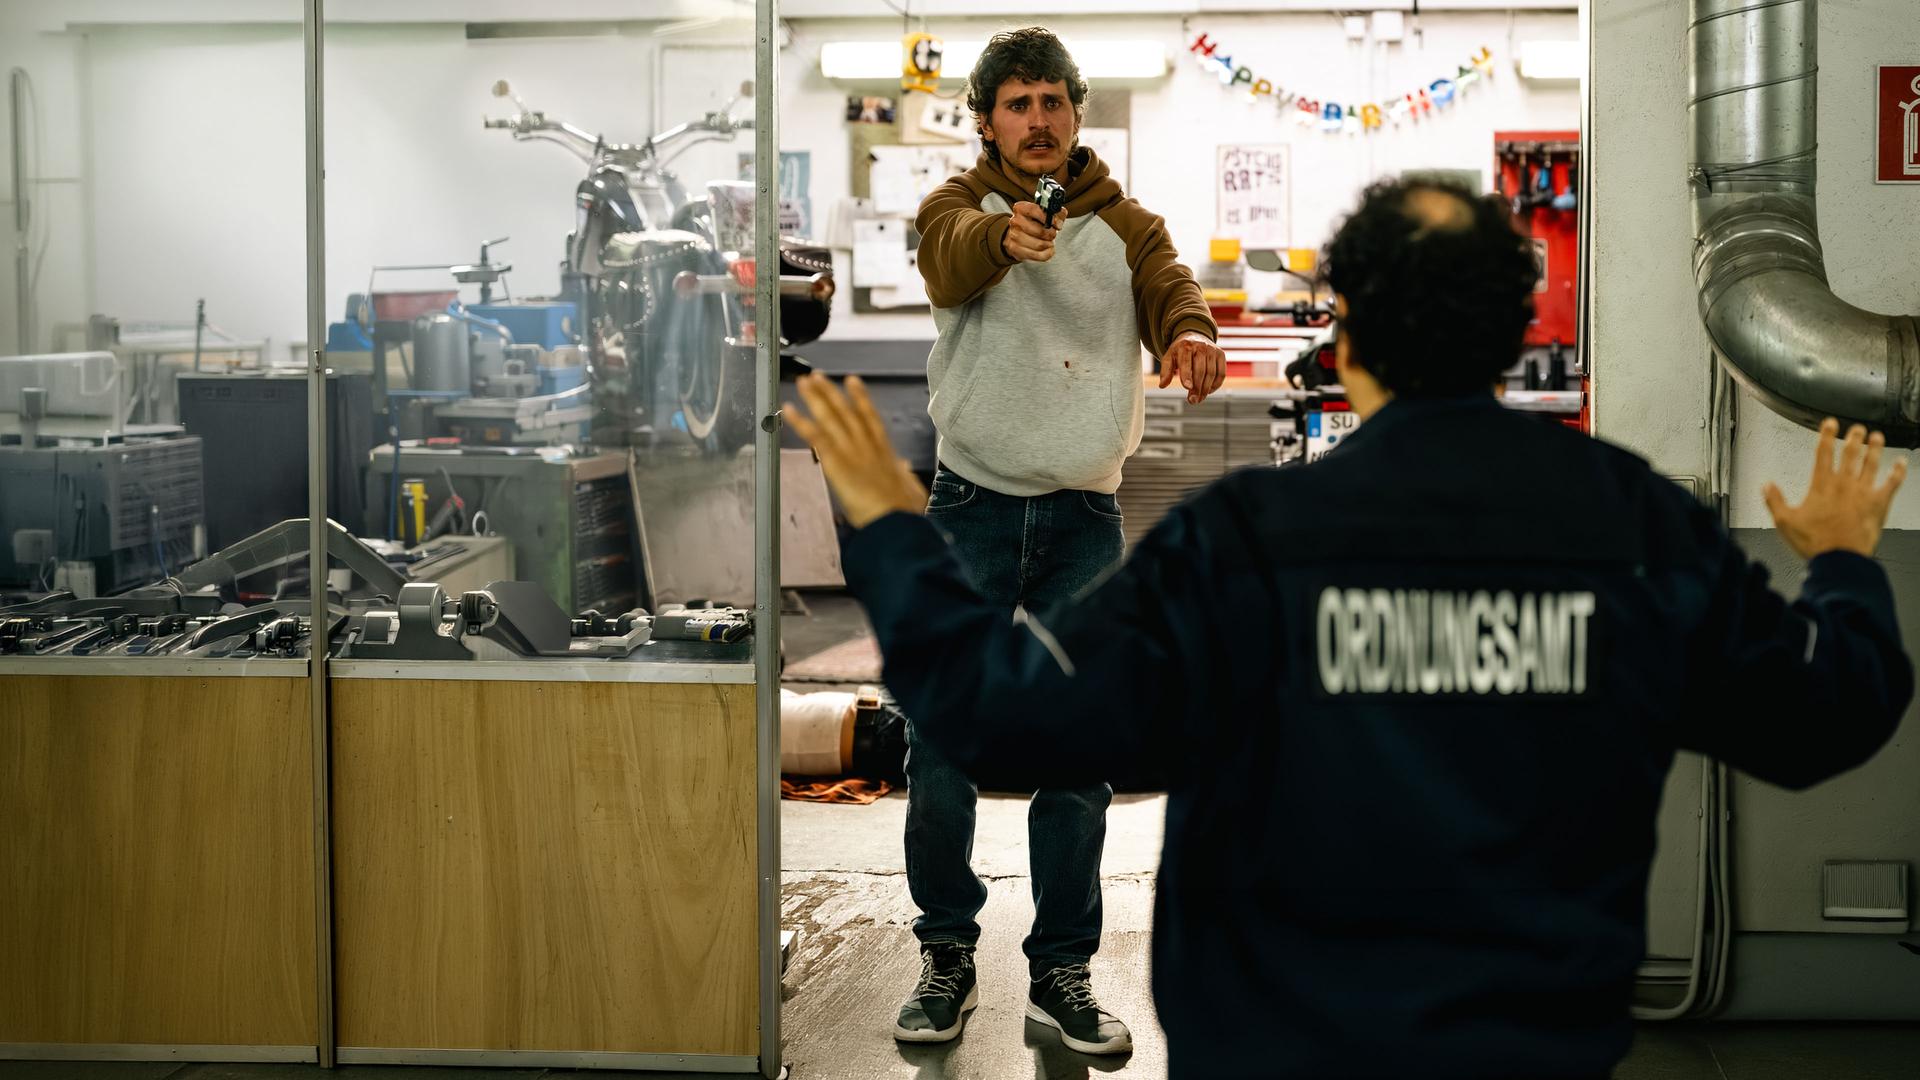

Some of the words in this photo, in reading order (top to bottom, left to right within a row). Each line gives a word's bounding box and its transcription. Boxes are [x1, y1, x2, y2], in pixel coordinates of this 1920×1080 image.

[1190, 33, 1294, 117] HAPPY
[1330, 415, 1353, 430] SU
[1317, 587, 1595, 694] ORDNUNGSAMT
